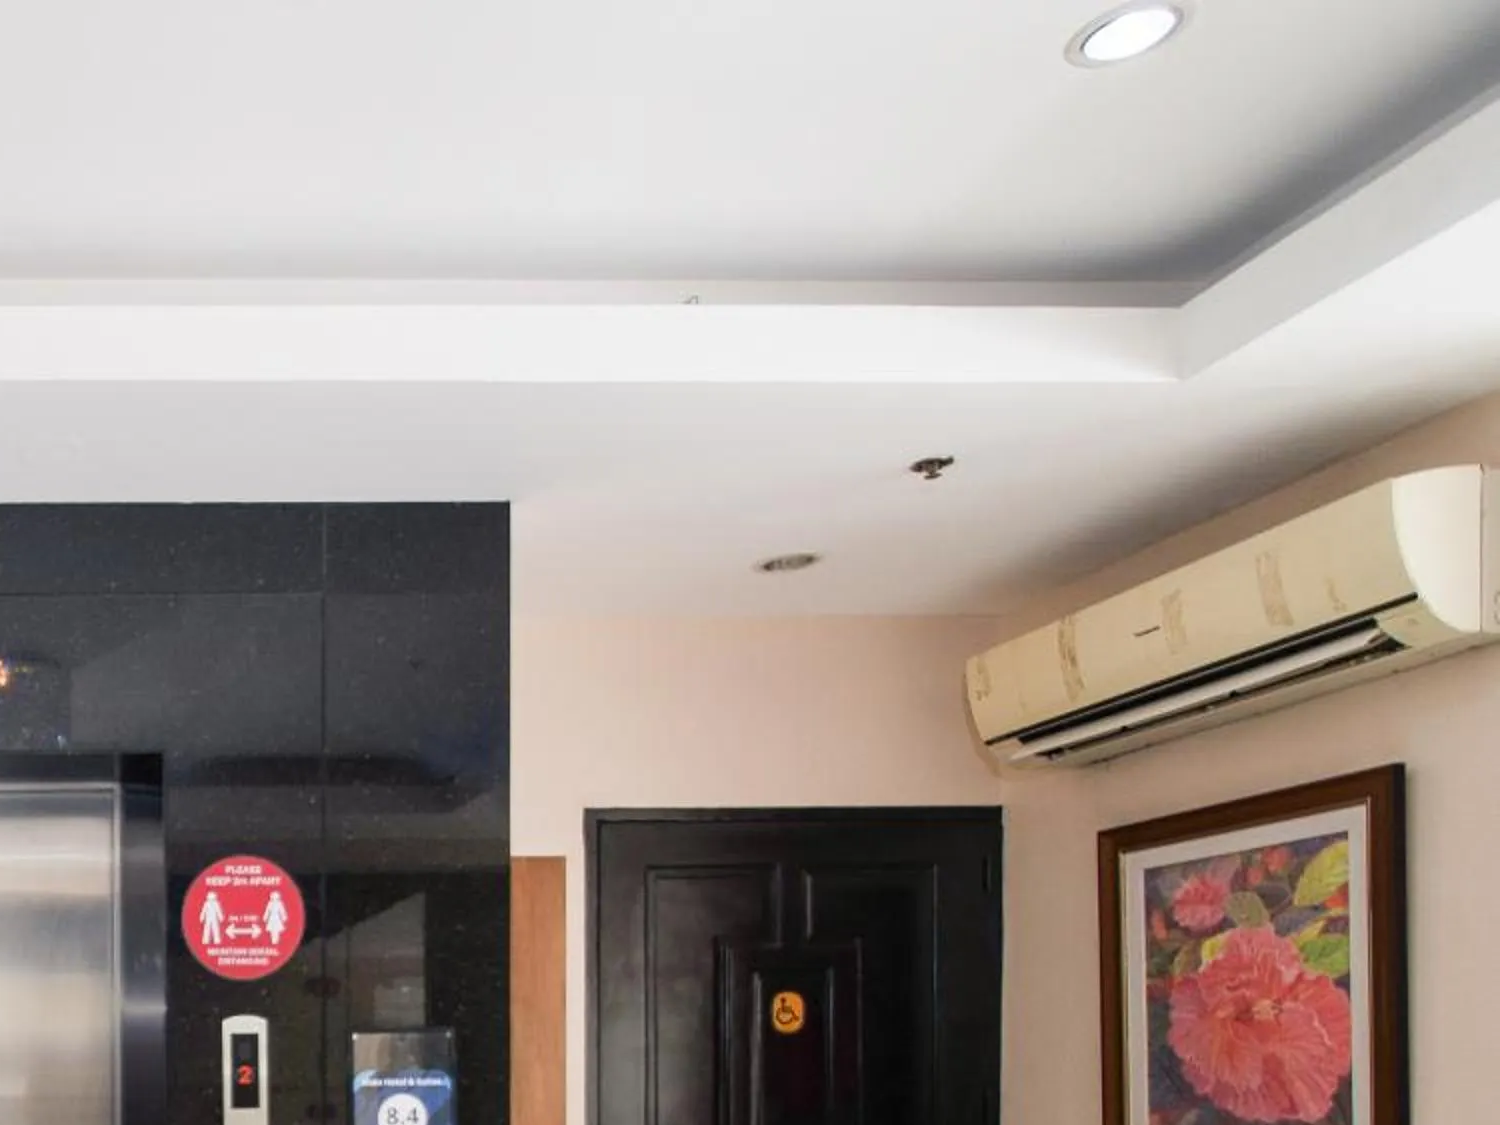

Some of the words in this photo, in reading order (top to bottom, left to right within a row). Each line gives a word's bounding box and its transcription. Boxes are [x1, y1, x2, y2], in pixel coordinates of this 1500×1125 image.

[225, 865, 262, 874] PLEASE
[205, 876, 231, 886] KEEP
[249, 876, 281, 886] APART
[236, 1064, 253, 1085] 2
[386, 1106, 419, 1125] 8.4
